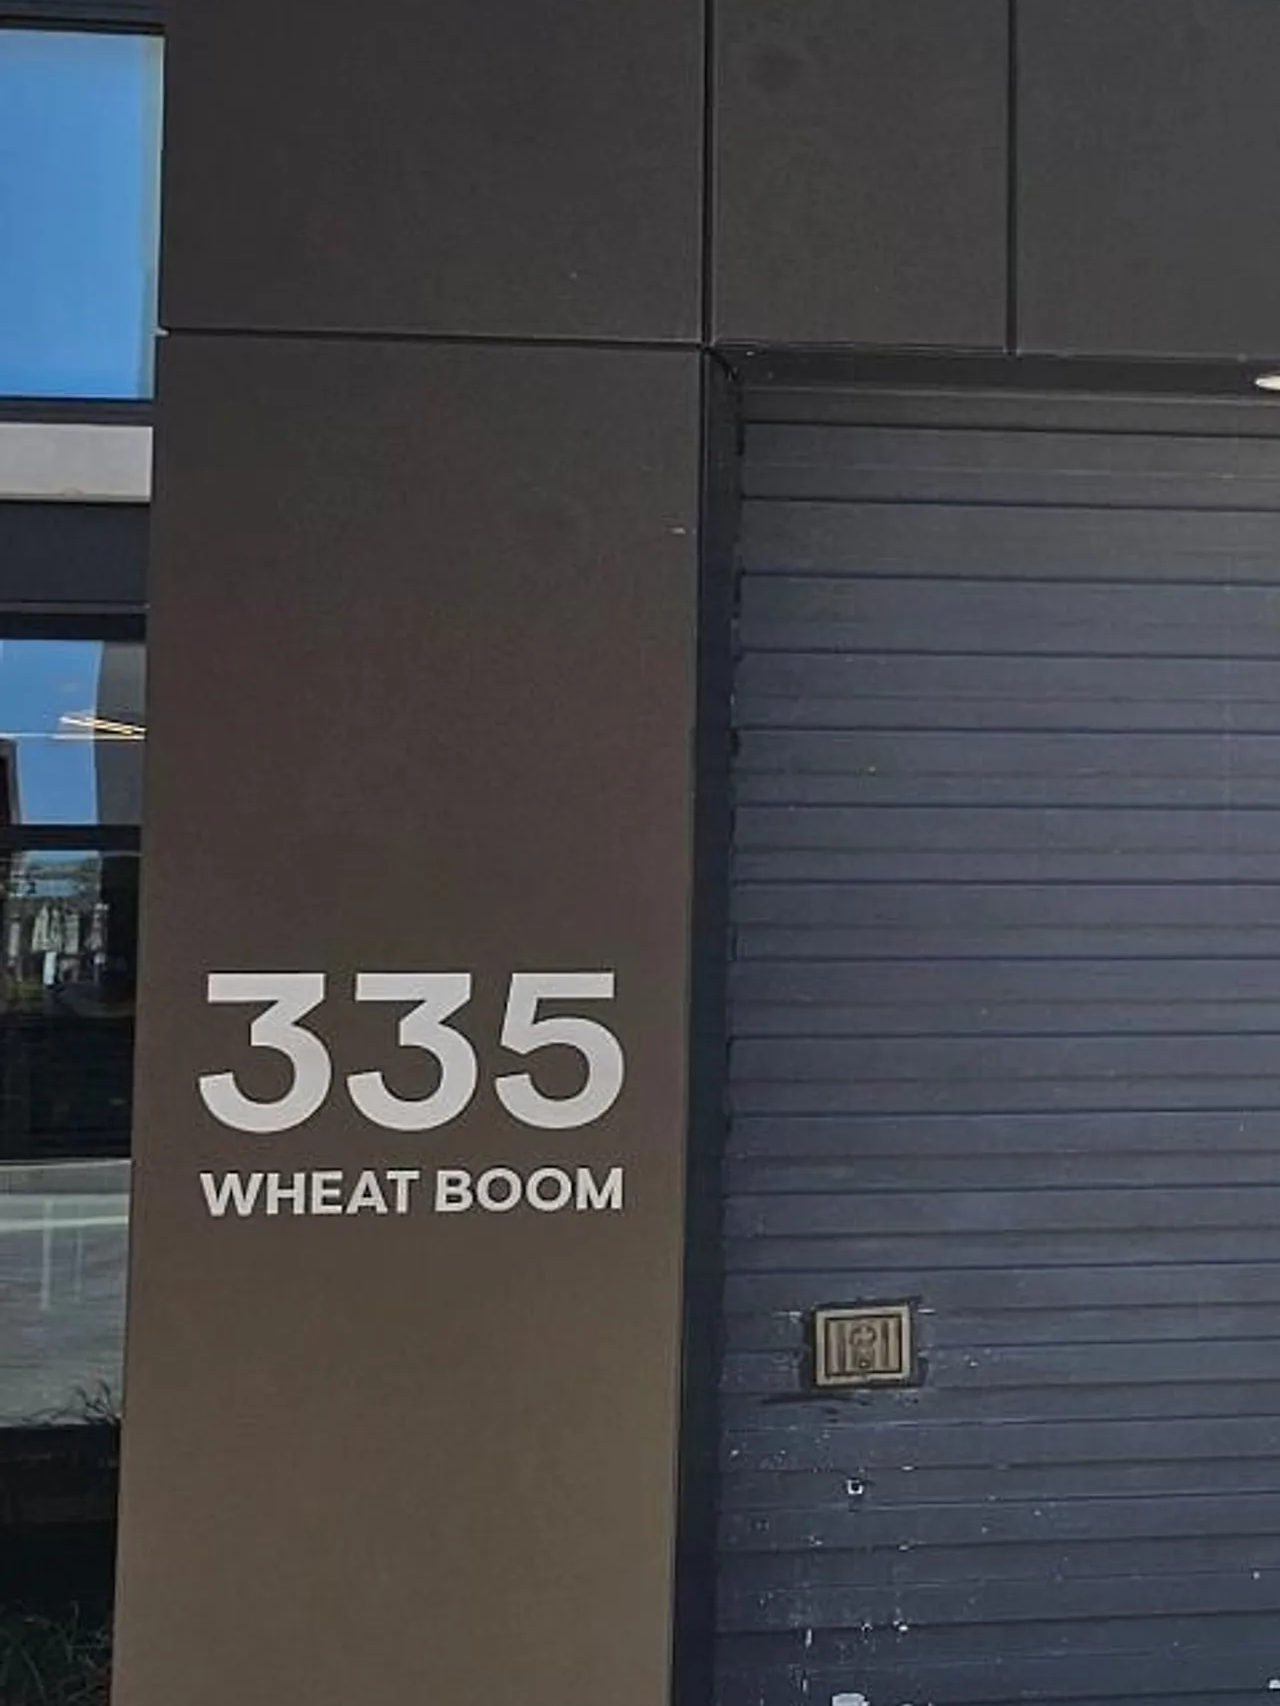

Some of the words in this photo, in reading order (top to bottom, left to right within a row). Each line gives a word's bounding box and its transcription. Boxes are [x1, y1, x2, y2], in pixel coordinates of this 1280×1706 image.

[198, 972, 625, 1133] 335
[200, 1170, 419, 1216] WHEAT
[434, 1166, 623, 1212] BOOM
